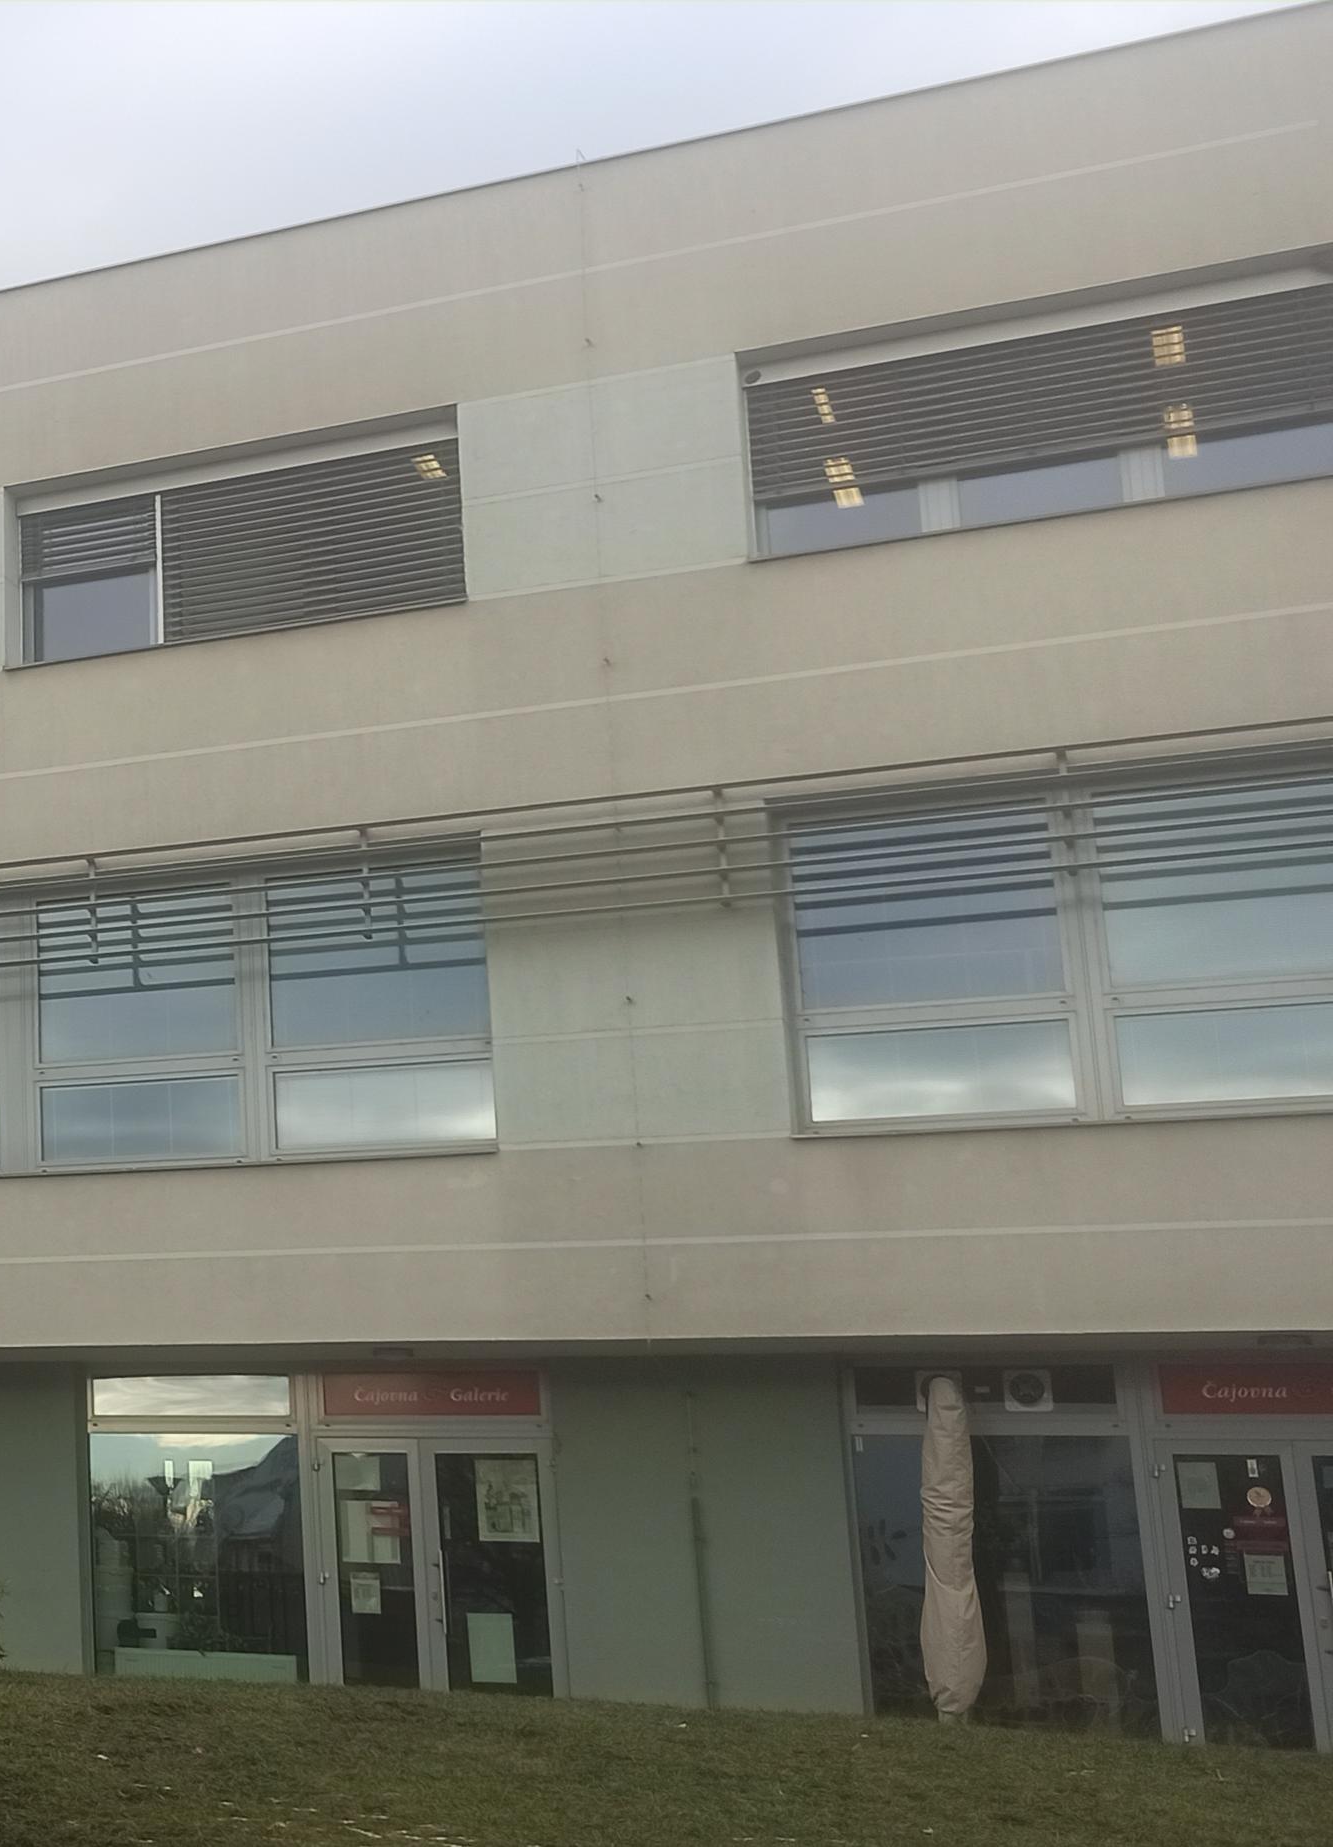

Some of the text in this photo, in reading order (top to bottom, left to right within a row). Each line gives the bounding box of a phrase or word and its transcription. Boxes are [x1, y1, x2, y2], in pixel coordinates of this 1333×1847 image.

[353, 1385, 418, 1406] Čajovna
[450, 1387, 511, 1402] Galerie
[1202, 1380, 1288, 1402] Čajovna
